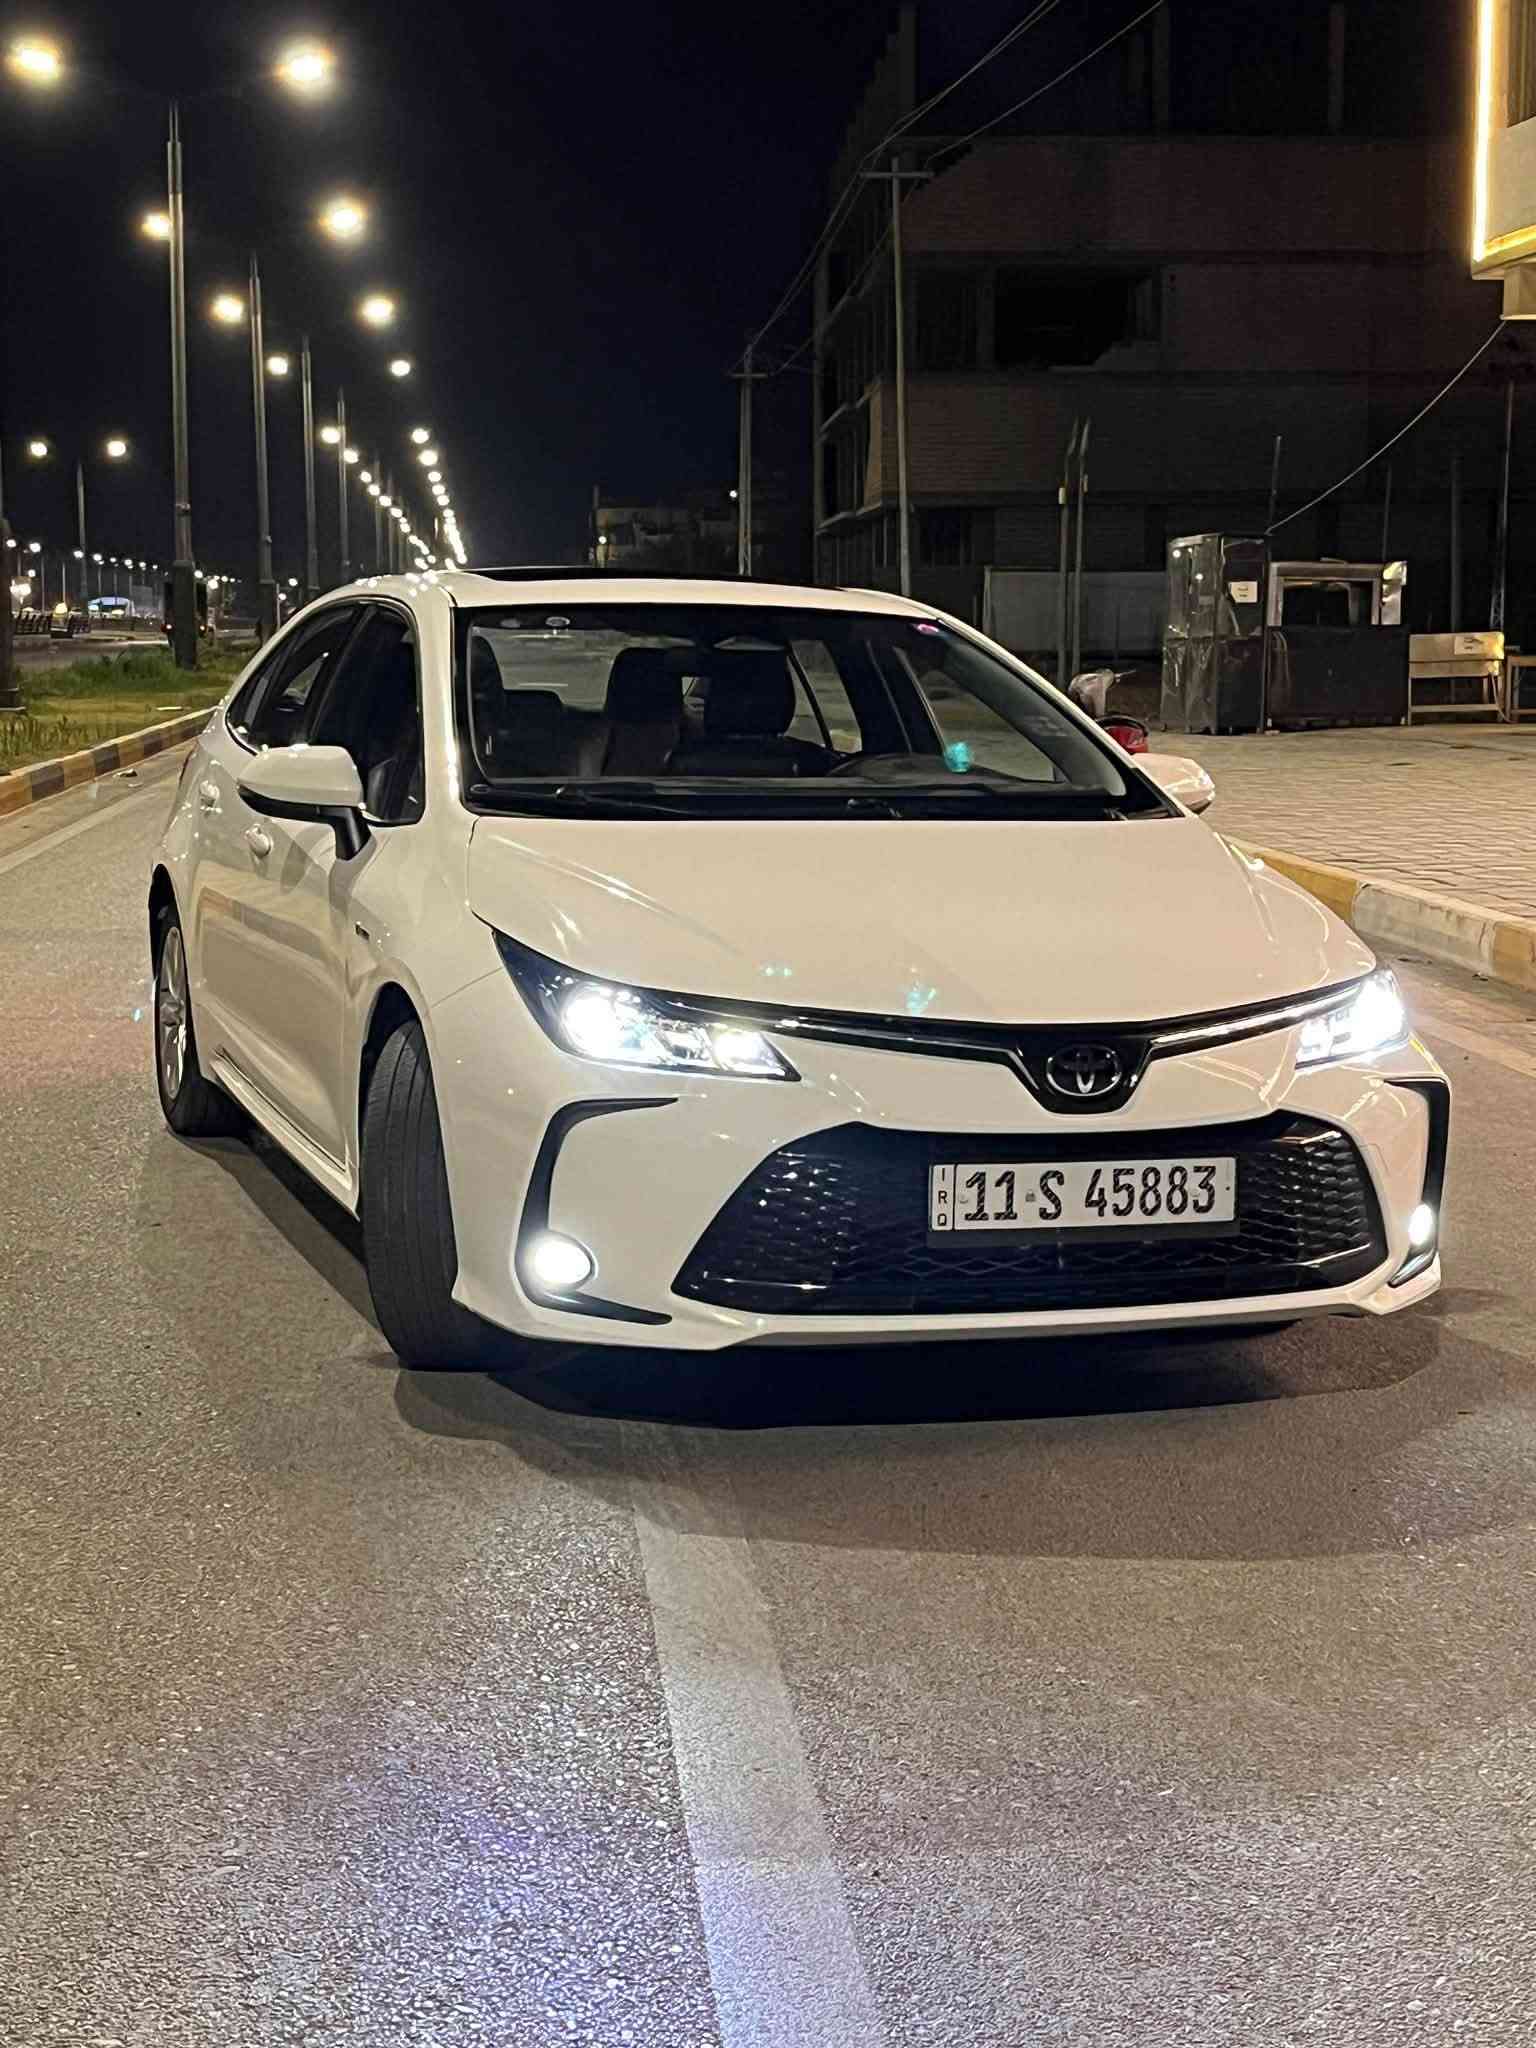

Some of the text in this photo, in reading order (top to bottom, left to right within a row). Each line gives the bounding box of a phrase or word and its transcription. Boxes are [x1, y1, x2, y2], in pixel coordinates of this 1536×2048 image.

[964, 1165, 1217, 1221] 11 S 45883
